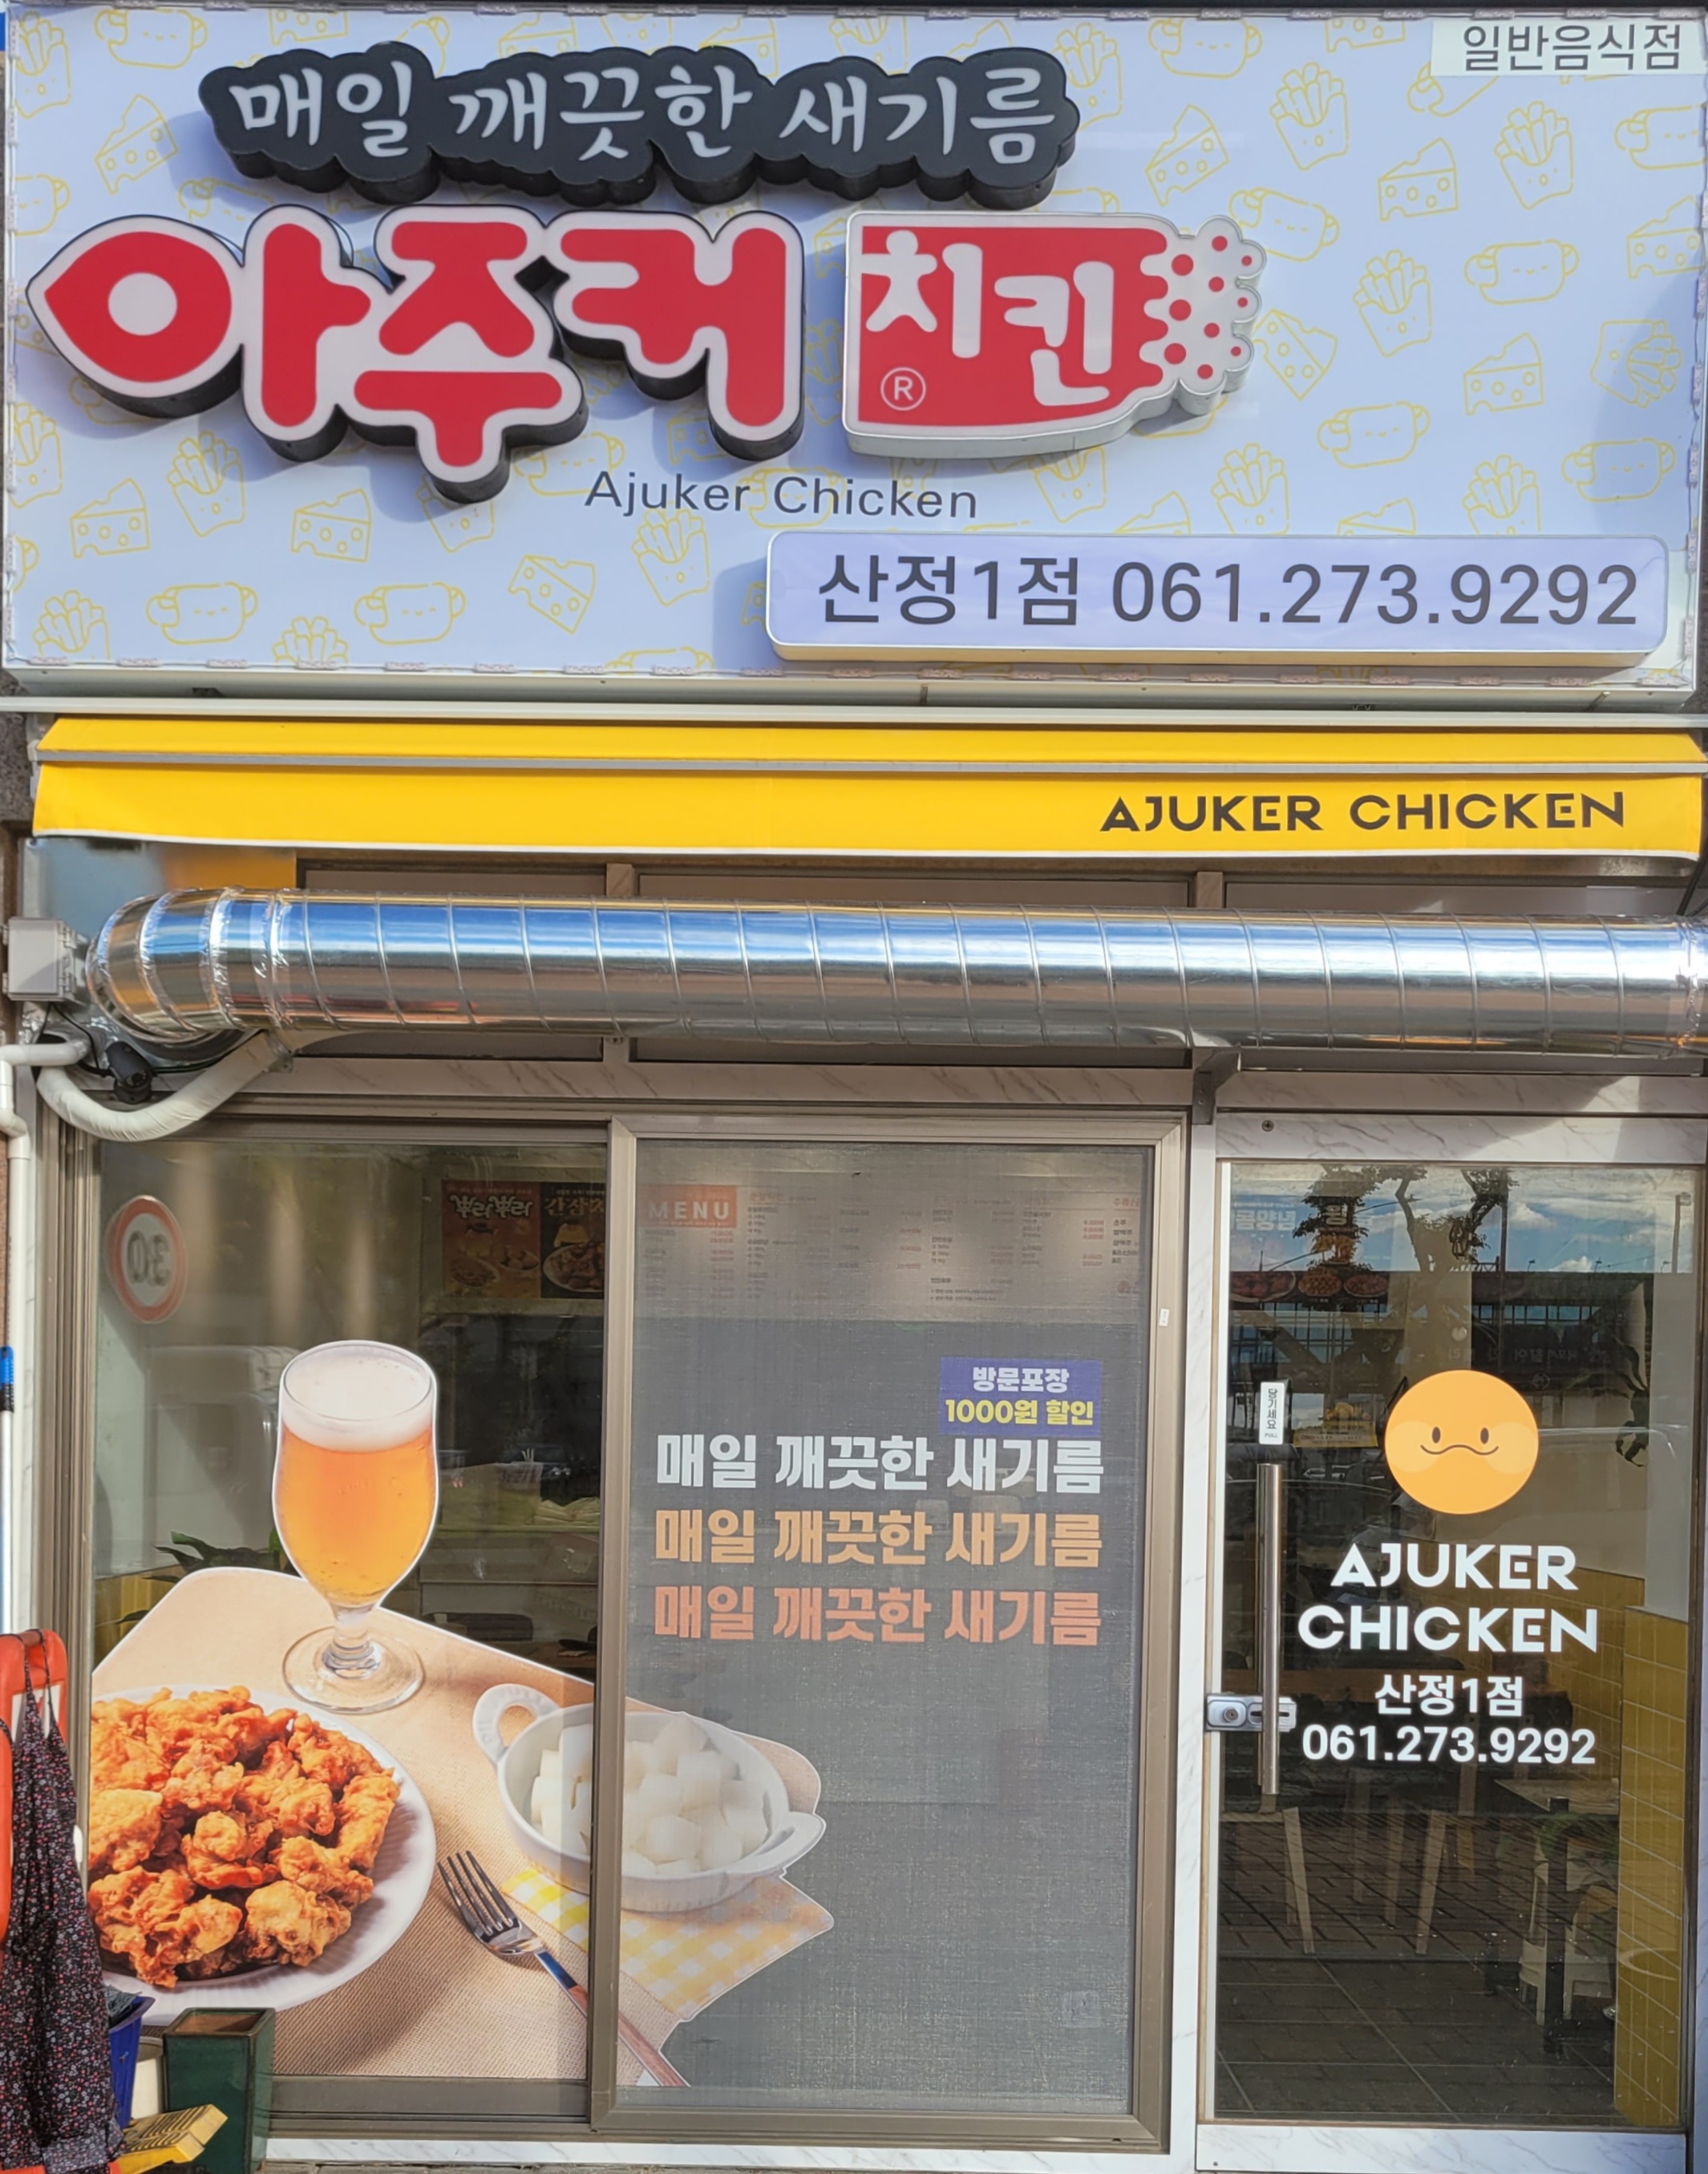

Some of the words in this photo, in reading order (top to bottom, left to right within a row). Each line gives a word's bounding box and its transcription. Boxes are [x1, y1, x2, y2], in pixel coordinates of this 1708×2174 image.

[1463, 24, 1681, 71] 일반음식점
[229, 61, 412, 157] 매일
[449, 65, 753, 161] 깨끗한
[779, 67, 1055, 164] 새기름
[44, 220, 787, 468] 아주커
[862, 230, 1115, 407] 치킨
[584, 470, 751, 516] Ajuker
[773, 476, 977, 518] Chicken
[818, 553, 1079, 627] 산정1점
[1112, 561, 1638, 627] 061.273.9292
[1099, 795, 1323, 832] AJUKER
[1349, 791, 1625, 830] CHICKEN
[648, 1200, 731, 1221] MENU
[973, 1366, 1070, 1394] 방문포장
[945, 1399, 1038, 1425] 1000원
[1046, 1399, 1094, 1426] 할인
[1266, 1388, 1278, 1429] 당기세요
[656, 1434, 757, 1488] 매일
[775, 1435, 933, 1490] 깨끗한
[945, 1438, 1104, 1494] 새기름
[654, 1508, 755, 1564] 매일
[773, 1510, 932, 1566] 깨끗한
[945, 1512, 1103, 1569] 새기름
[1330, 1543, 1579, 1591] AJUKER
[654, 1585, 755, 1641] 매일
[771, 1586, 931, 1643] 깨끗한
[943, 1589, 1102, 1647] 새기름
[1297, 1605, 1597, 1654] CHICKEN
[1374, 1674, 1523, 1718] 산정1점
[1302, 1723, 1596, 1765] 061.273.9292
